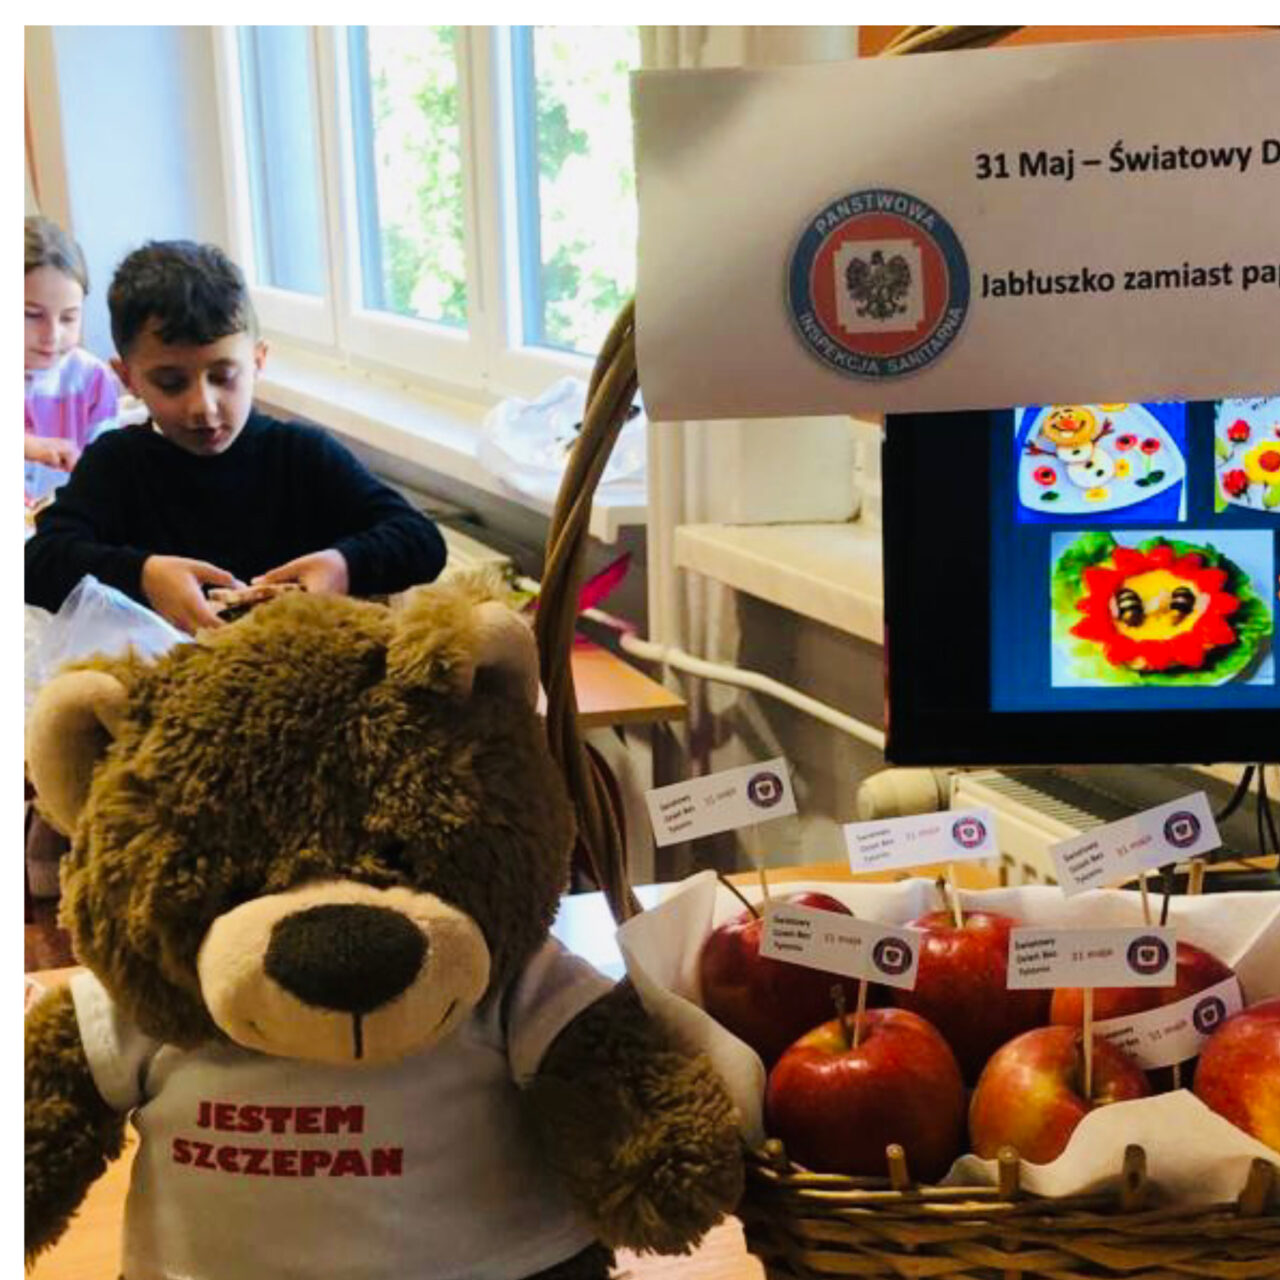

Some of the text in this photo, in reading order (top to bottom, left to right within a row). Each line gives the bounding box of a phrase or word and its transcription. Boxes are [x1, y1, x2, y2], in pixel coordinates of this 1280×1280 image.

[976, 153, 1010, 180] 31
[1019, 150, 1075, 181] Maj
[1109, 139, 1253, 173] Światowy
[982, 267, 1115, 298] Jabłuszko
[1123, 262, 1233, 290] zamiast
[196, 1101, 365, 1134] JESTEM
[172, 1137, 405, 1177] SZCZEPAN
